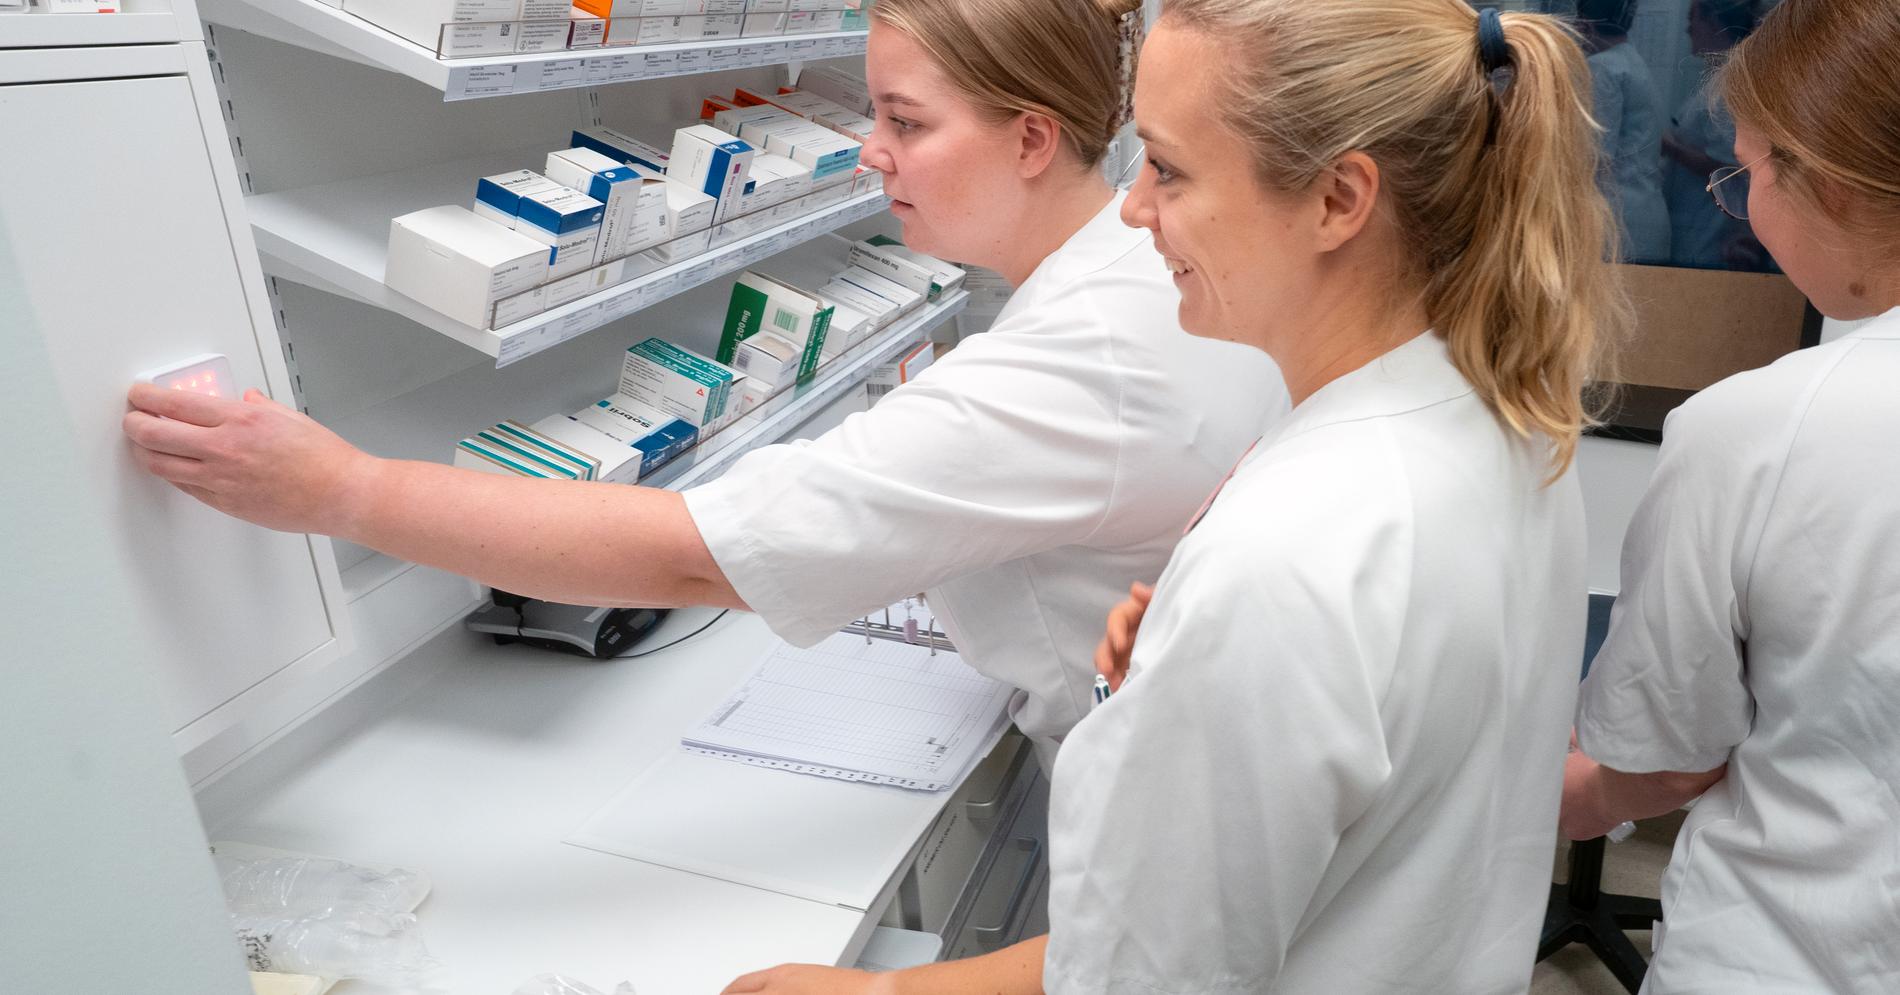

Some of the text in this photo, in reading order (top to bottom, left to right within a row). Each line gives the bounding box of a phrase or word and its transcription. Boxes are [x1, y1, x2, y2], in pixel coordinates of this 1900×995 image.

[735, 309, 751, 339] 200 mg
[608, 407, 652, 428] Sobril
